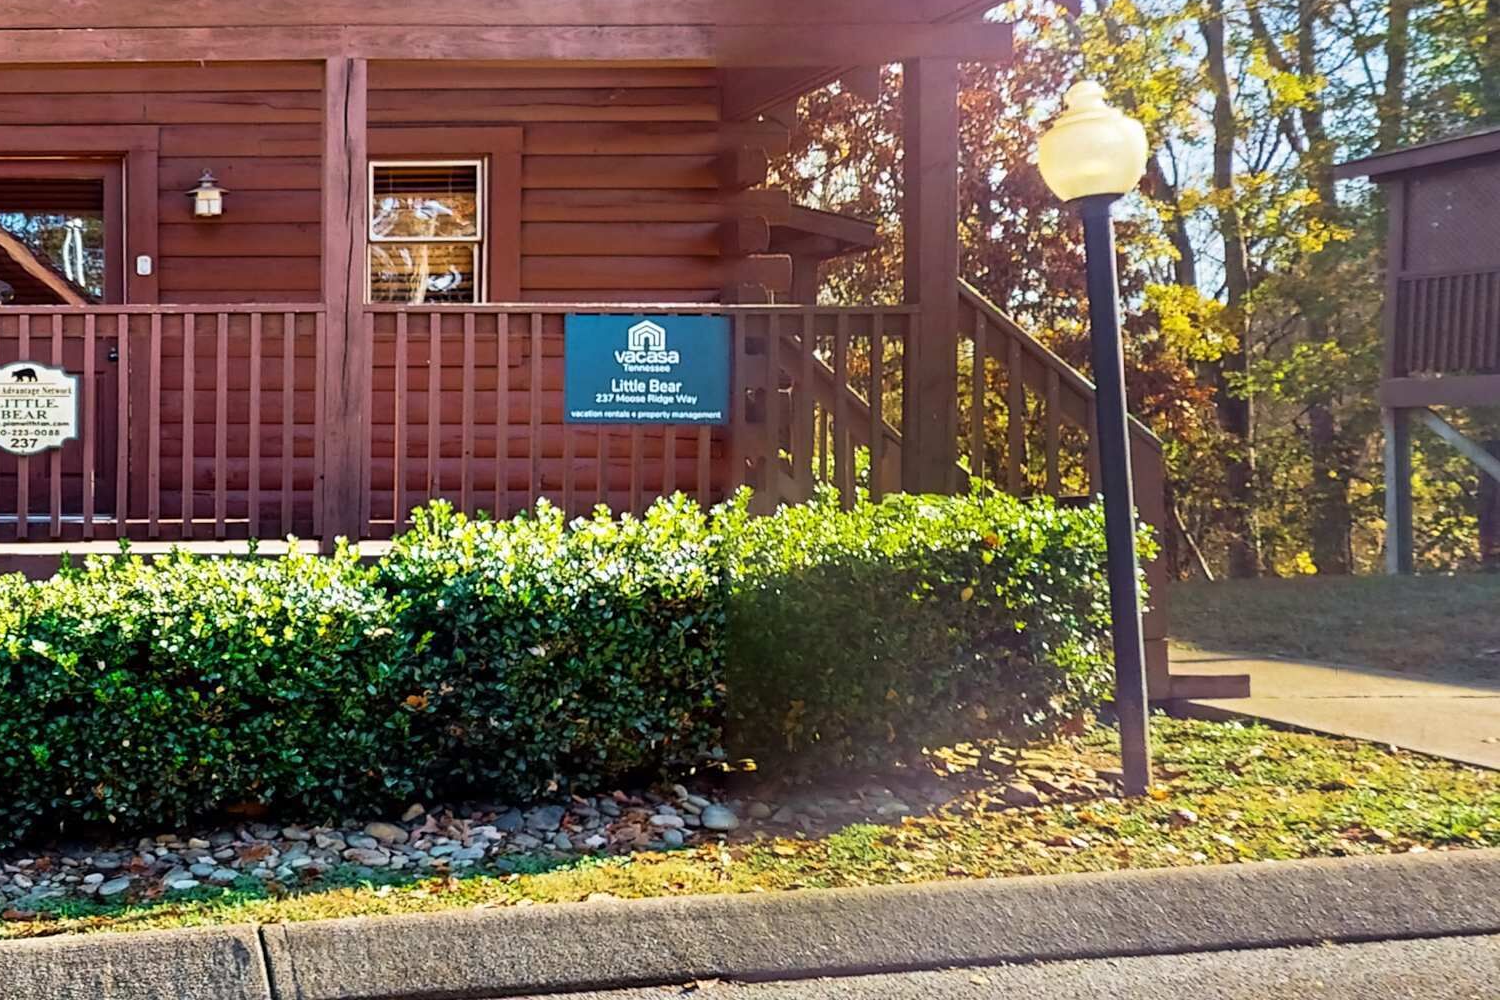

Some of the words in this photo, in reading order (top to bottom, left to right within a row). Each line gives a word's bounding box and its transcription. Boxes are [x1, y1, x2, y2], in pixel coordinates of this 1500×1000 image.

[614, 351, 680, 364] vacasa
[623, 364, 671, 373] Tennessee
[2, 386, 40, 396] Advantage
[43, 386, 72, 395] Network
[611, 378, 646, 393] Little
[649, 378, 683, 393] Bear
[595, 394, 614, 403] 237
[615, 394, 646, 403] Moose
[647, 394, 674, 405] Ridge
[675, 394, 698, 405] Way
[1, 409, 48, 420] BEAR
[570, 409, 603, 418] vacation
[604, 410, 631, 418] rentals
[637, 410, 670, 420] property
[671, 411, 722, 420] management
[10, 438, 38, 448] 237
